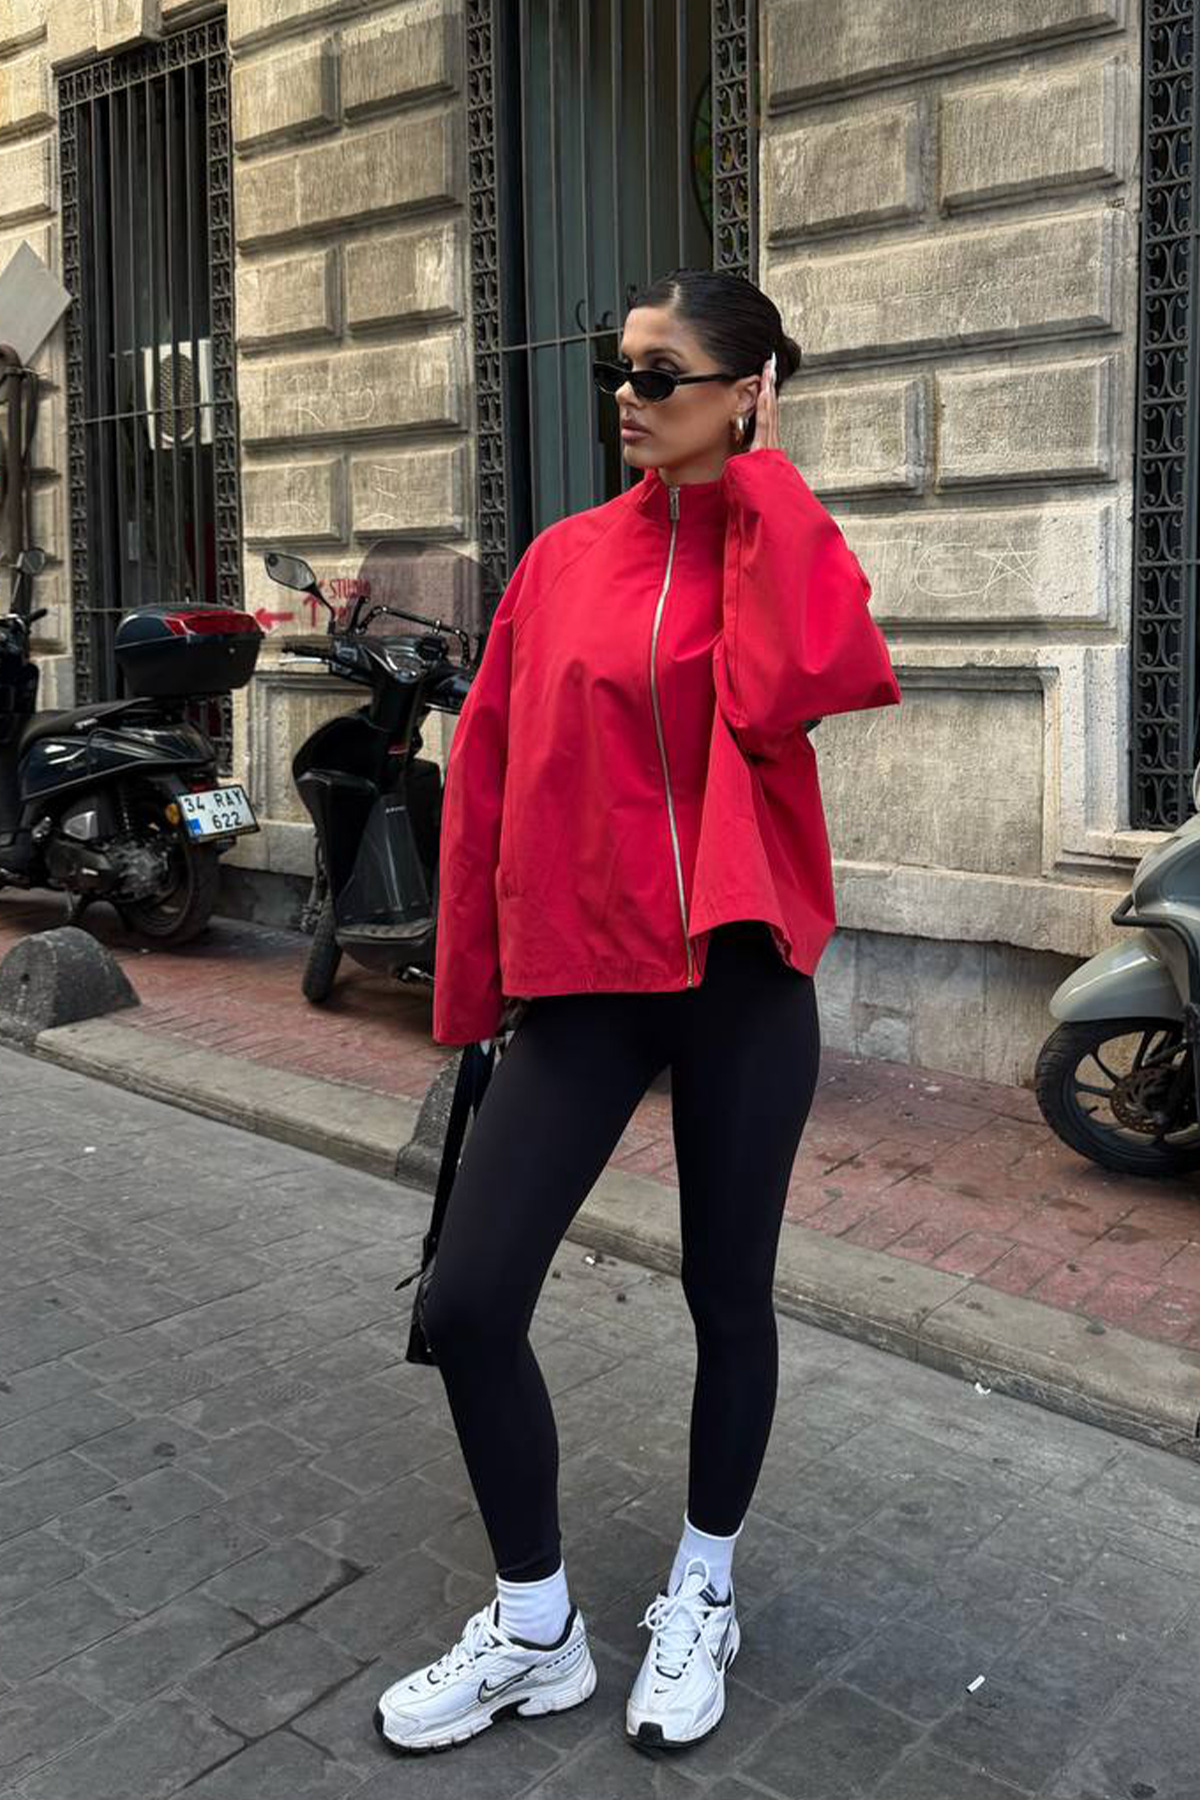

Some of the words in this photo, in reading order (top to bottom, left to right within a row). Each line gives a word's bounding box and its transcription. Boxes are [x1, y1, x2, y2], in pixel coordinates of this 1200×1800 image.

[183, 795, 206, 813] 34
[213, 789, 243, 808] RAY
[211, 810, 243, 830] 622
